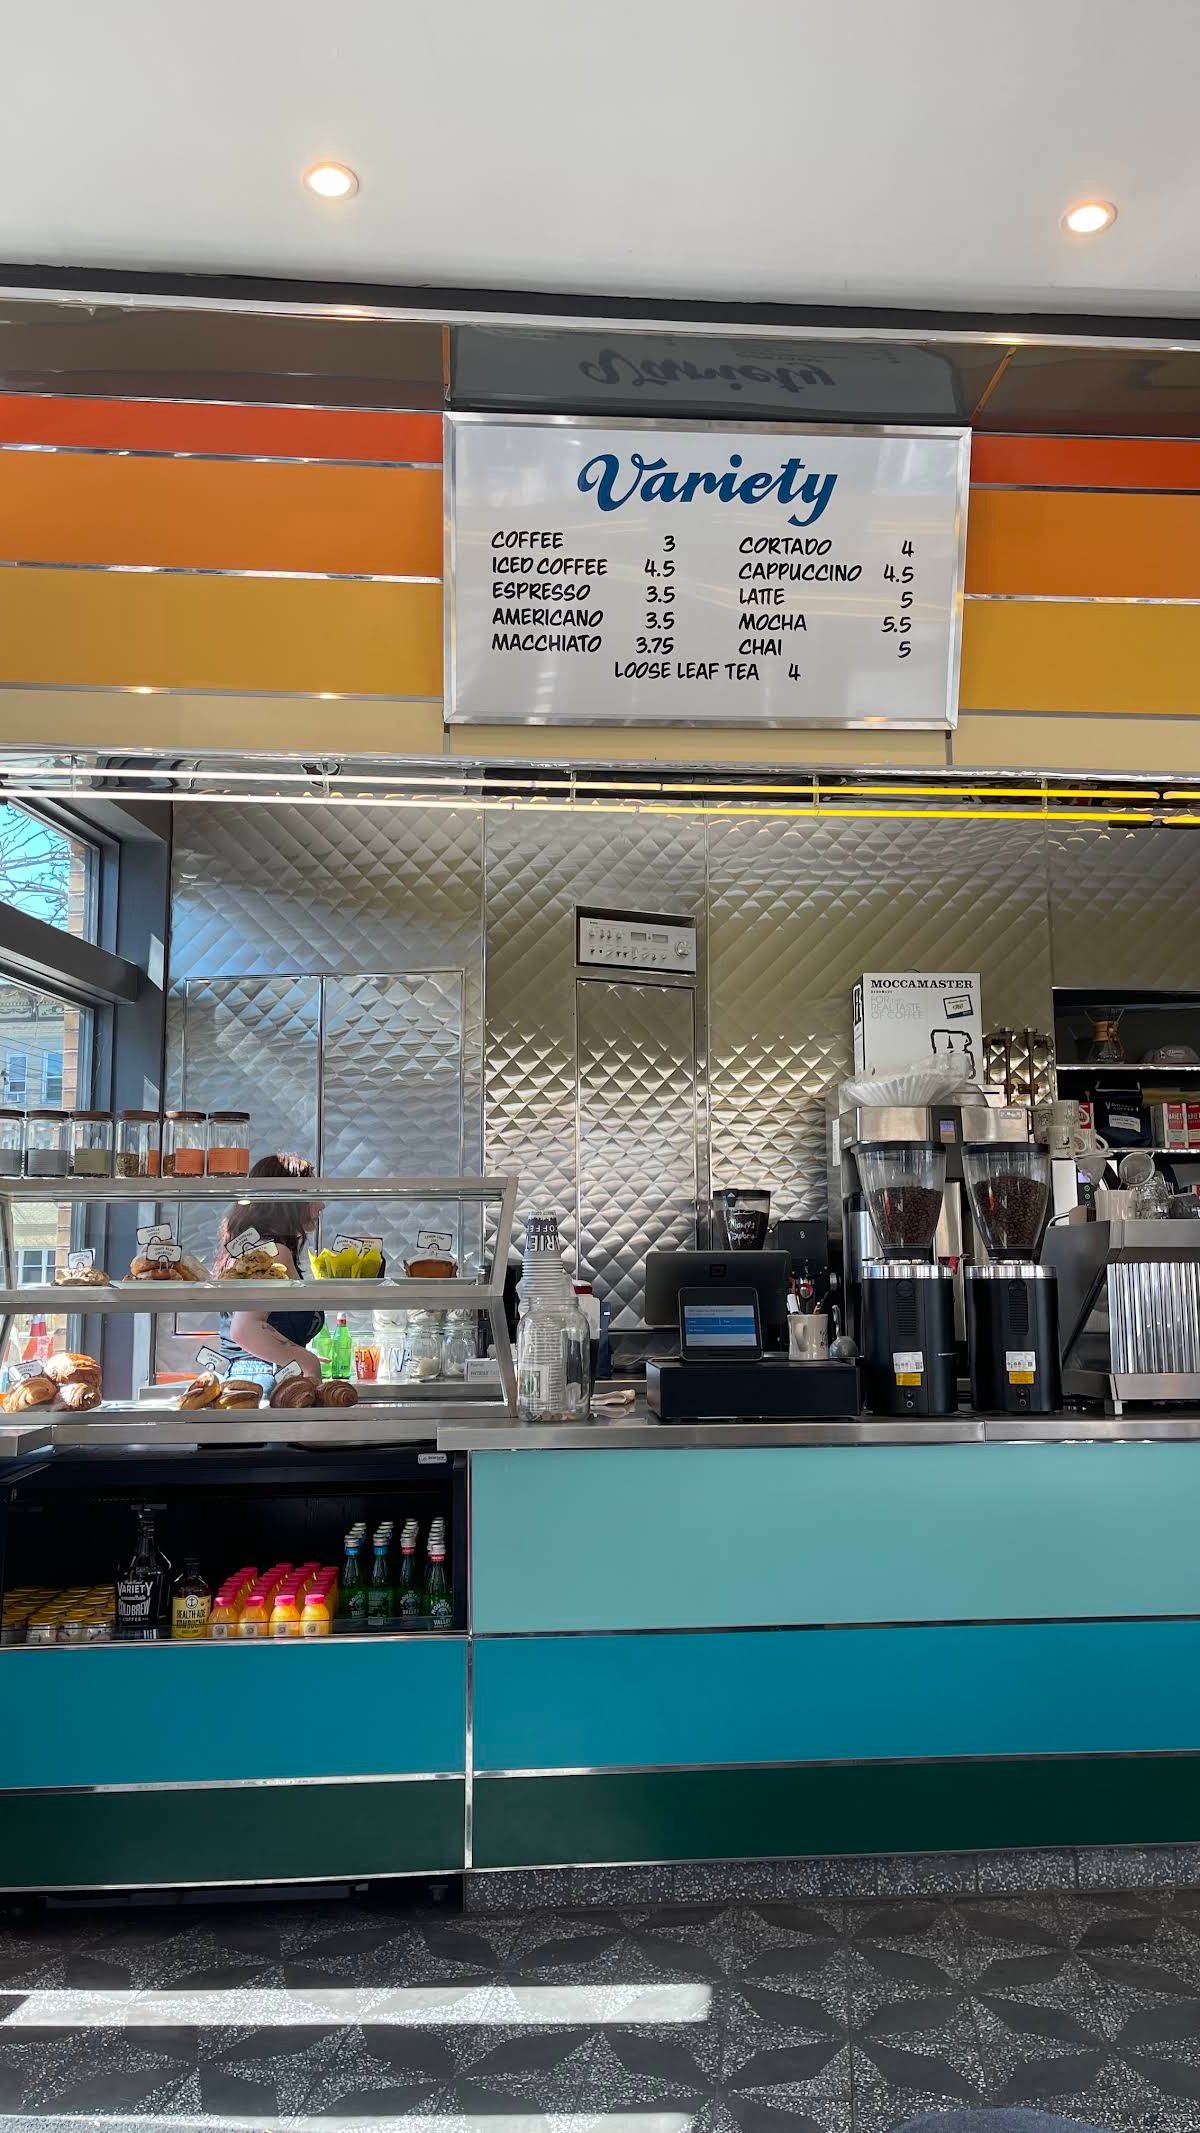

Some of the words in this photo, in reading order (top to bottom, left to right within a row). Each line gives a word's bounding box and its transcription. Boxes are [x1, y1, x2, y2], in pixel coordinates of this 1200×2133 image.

[578, 454, 838, 526] Variety
[491, 531, 563, 549] COFFEE
[663, 536, 675, 552] 3
[739, 537, 832, 555] CORTADO
[902, 540, 914, 557] 4
[493, 557, 533, 573] ICED
[537, 558, 607, 575] COFFEE
[645, 559, 675, 577] 4.5
[739, 563, 862, 581] CAPPUCCINO
[884, 564, 914, 583] 4.5
[493, 582, 590, 601] ESPRESSO
[646, 586, 675, 603] 3.5
[740, 588, 785, 605] LATTE
[901, 592, 913, 608] 5
[492, 608, 603, 627] AMERICANO
[645, 612, 674, 630] 3.5
[739, 613, 807, 631] MOCHA
[881, 616, 911, 633] 5.5
[492, 633, 601, 652] MACCHIATO
[636, 637, 674, 655] 3.75
[739, 639, 781, 656] CHAI
[898, 641, 911, 658] 5
[615, 662, 671, 679] LOOSE
[678, 662, 719, 679] LEAF
[725, 663, 759, 680] TEA
[788, 663, 800, 681] 4
[871, 980, 974, 989] MOCCAMASTER
[117, 1581, 154, 1597] VARIETY
[131, 1597, 151, 1615] BREW
